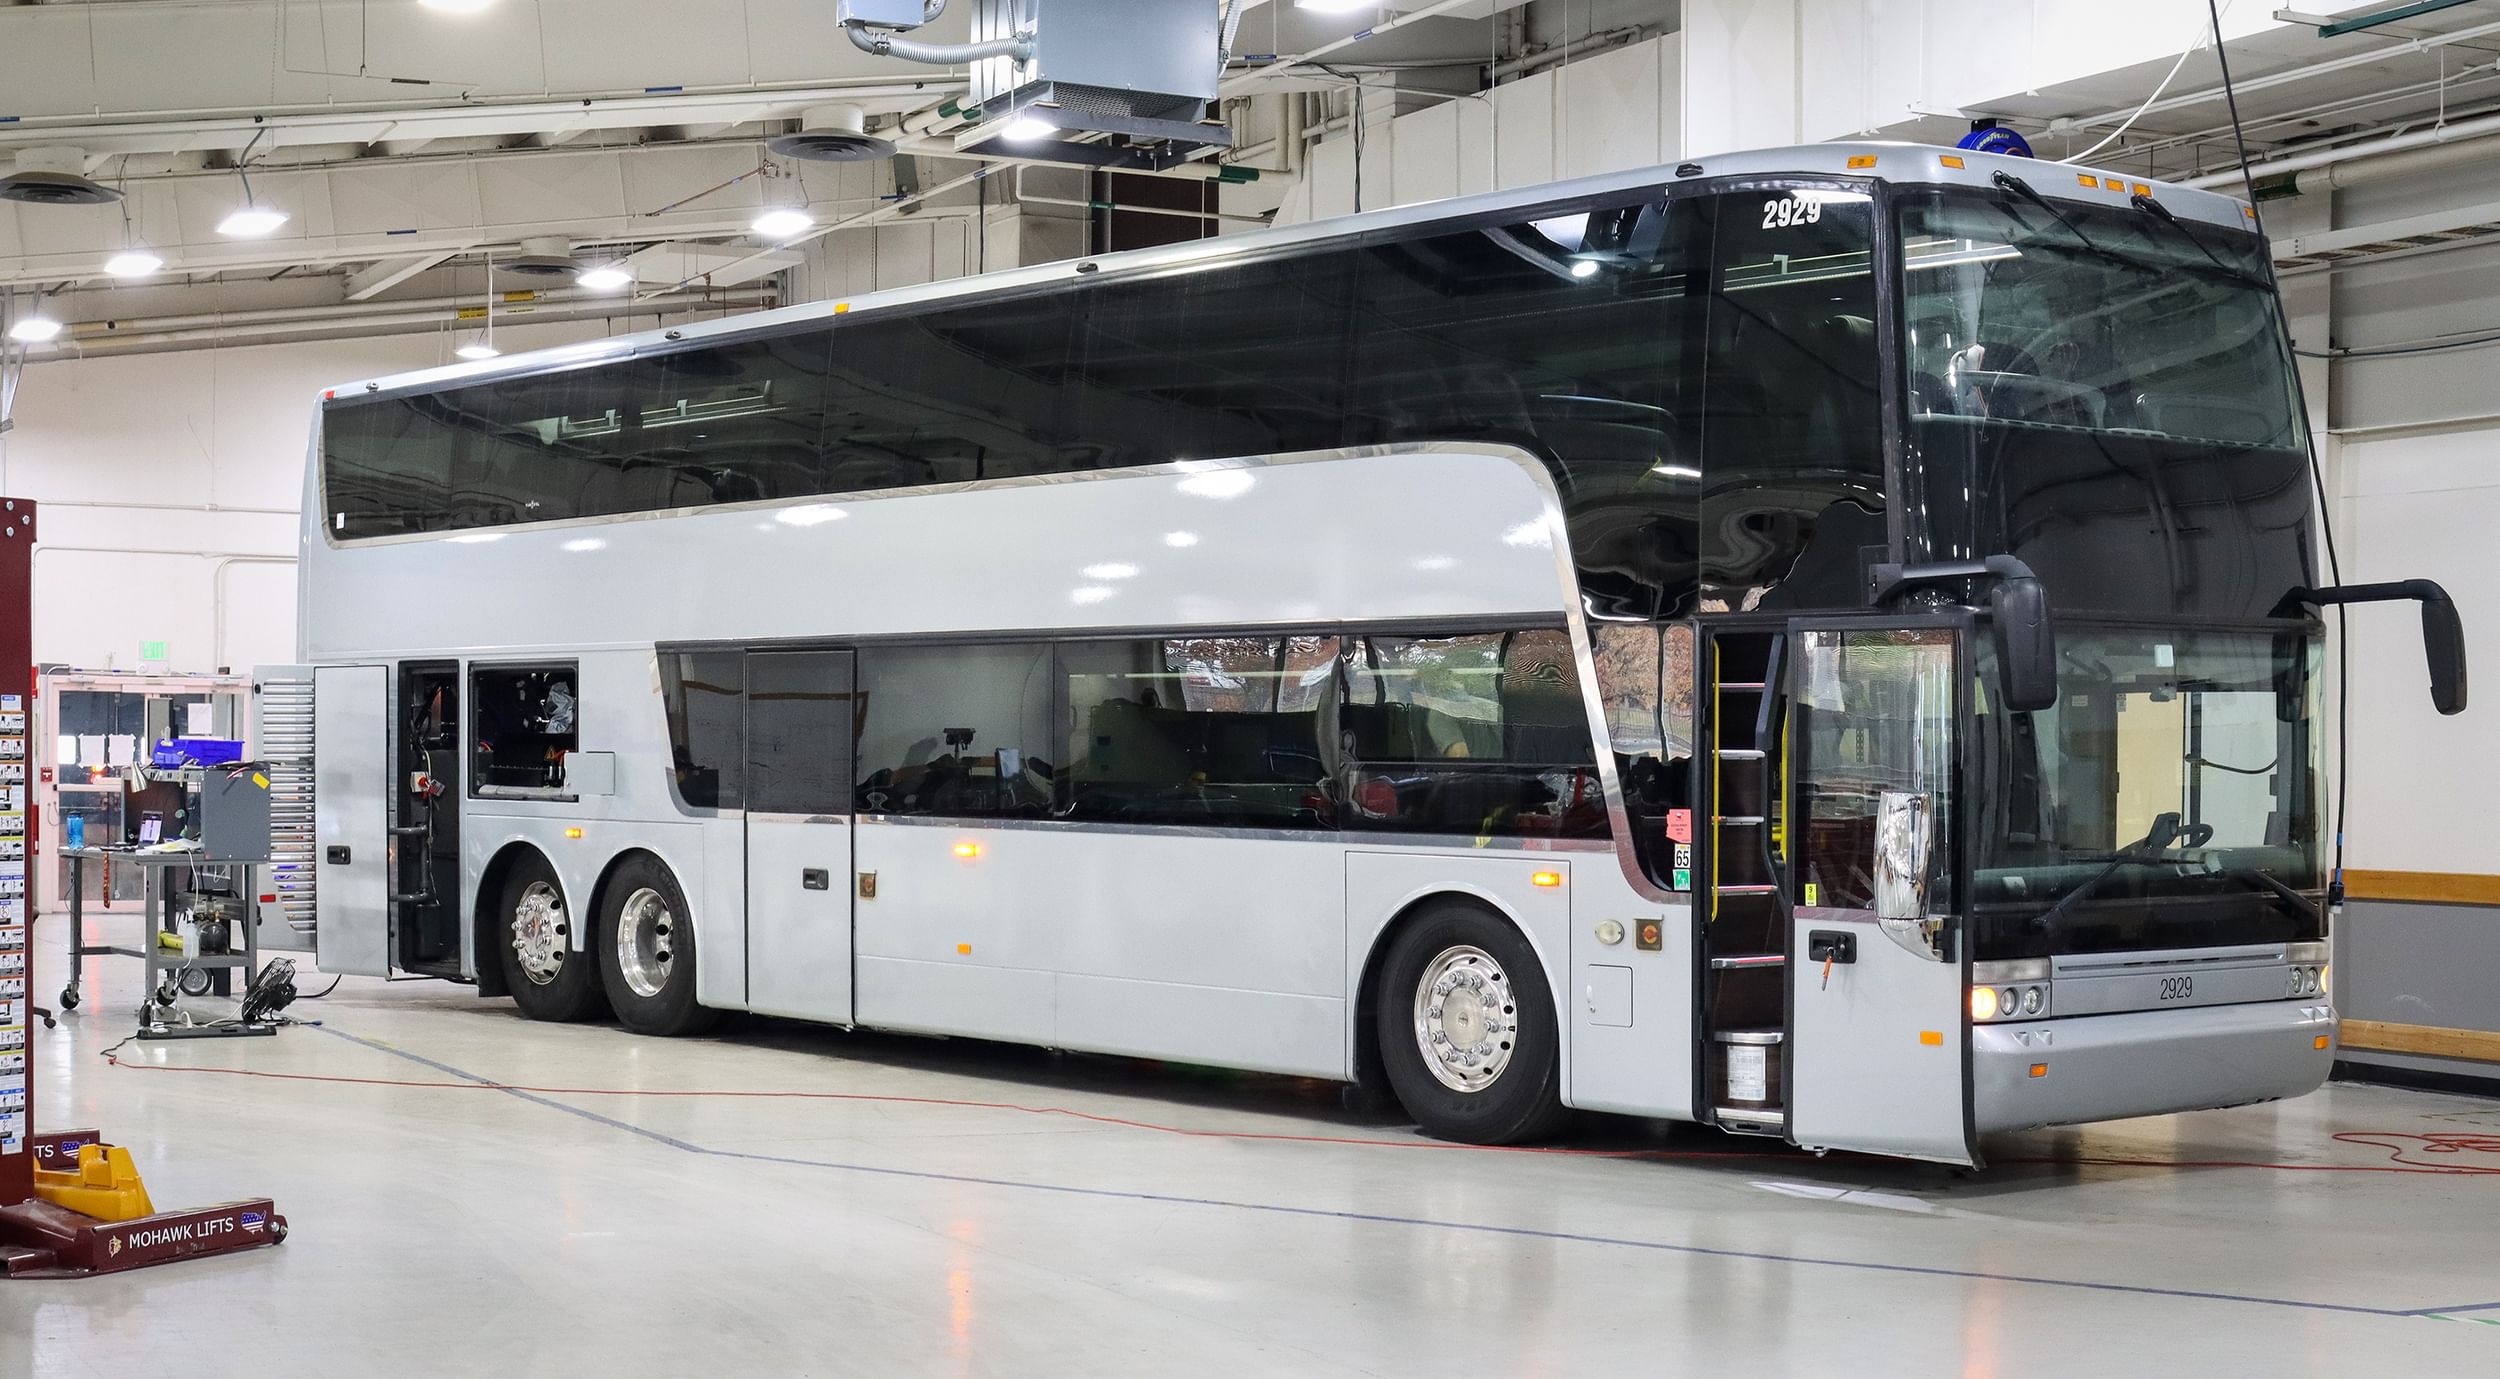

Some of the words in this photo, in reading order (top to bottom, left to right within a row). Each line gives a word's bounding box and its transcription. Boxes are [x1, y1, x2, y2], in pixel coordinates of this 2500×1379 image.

[1762, 197, 1822, 230] 2929
[143, 640, 167, 659] EXIT
[1675, 850, 1690, 867] 65
[2160, 976, 2193, 1000] 2929
[129, 1223, 193, 1249] MOHAWK
[197, 1217, 234, 1238] LIFTS
